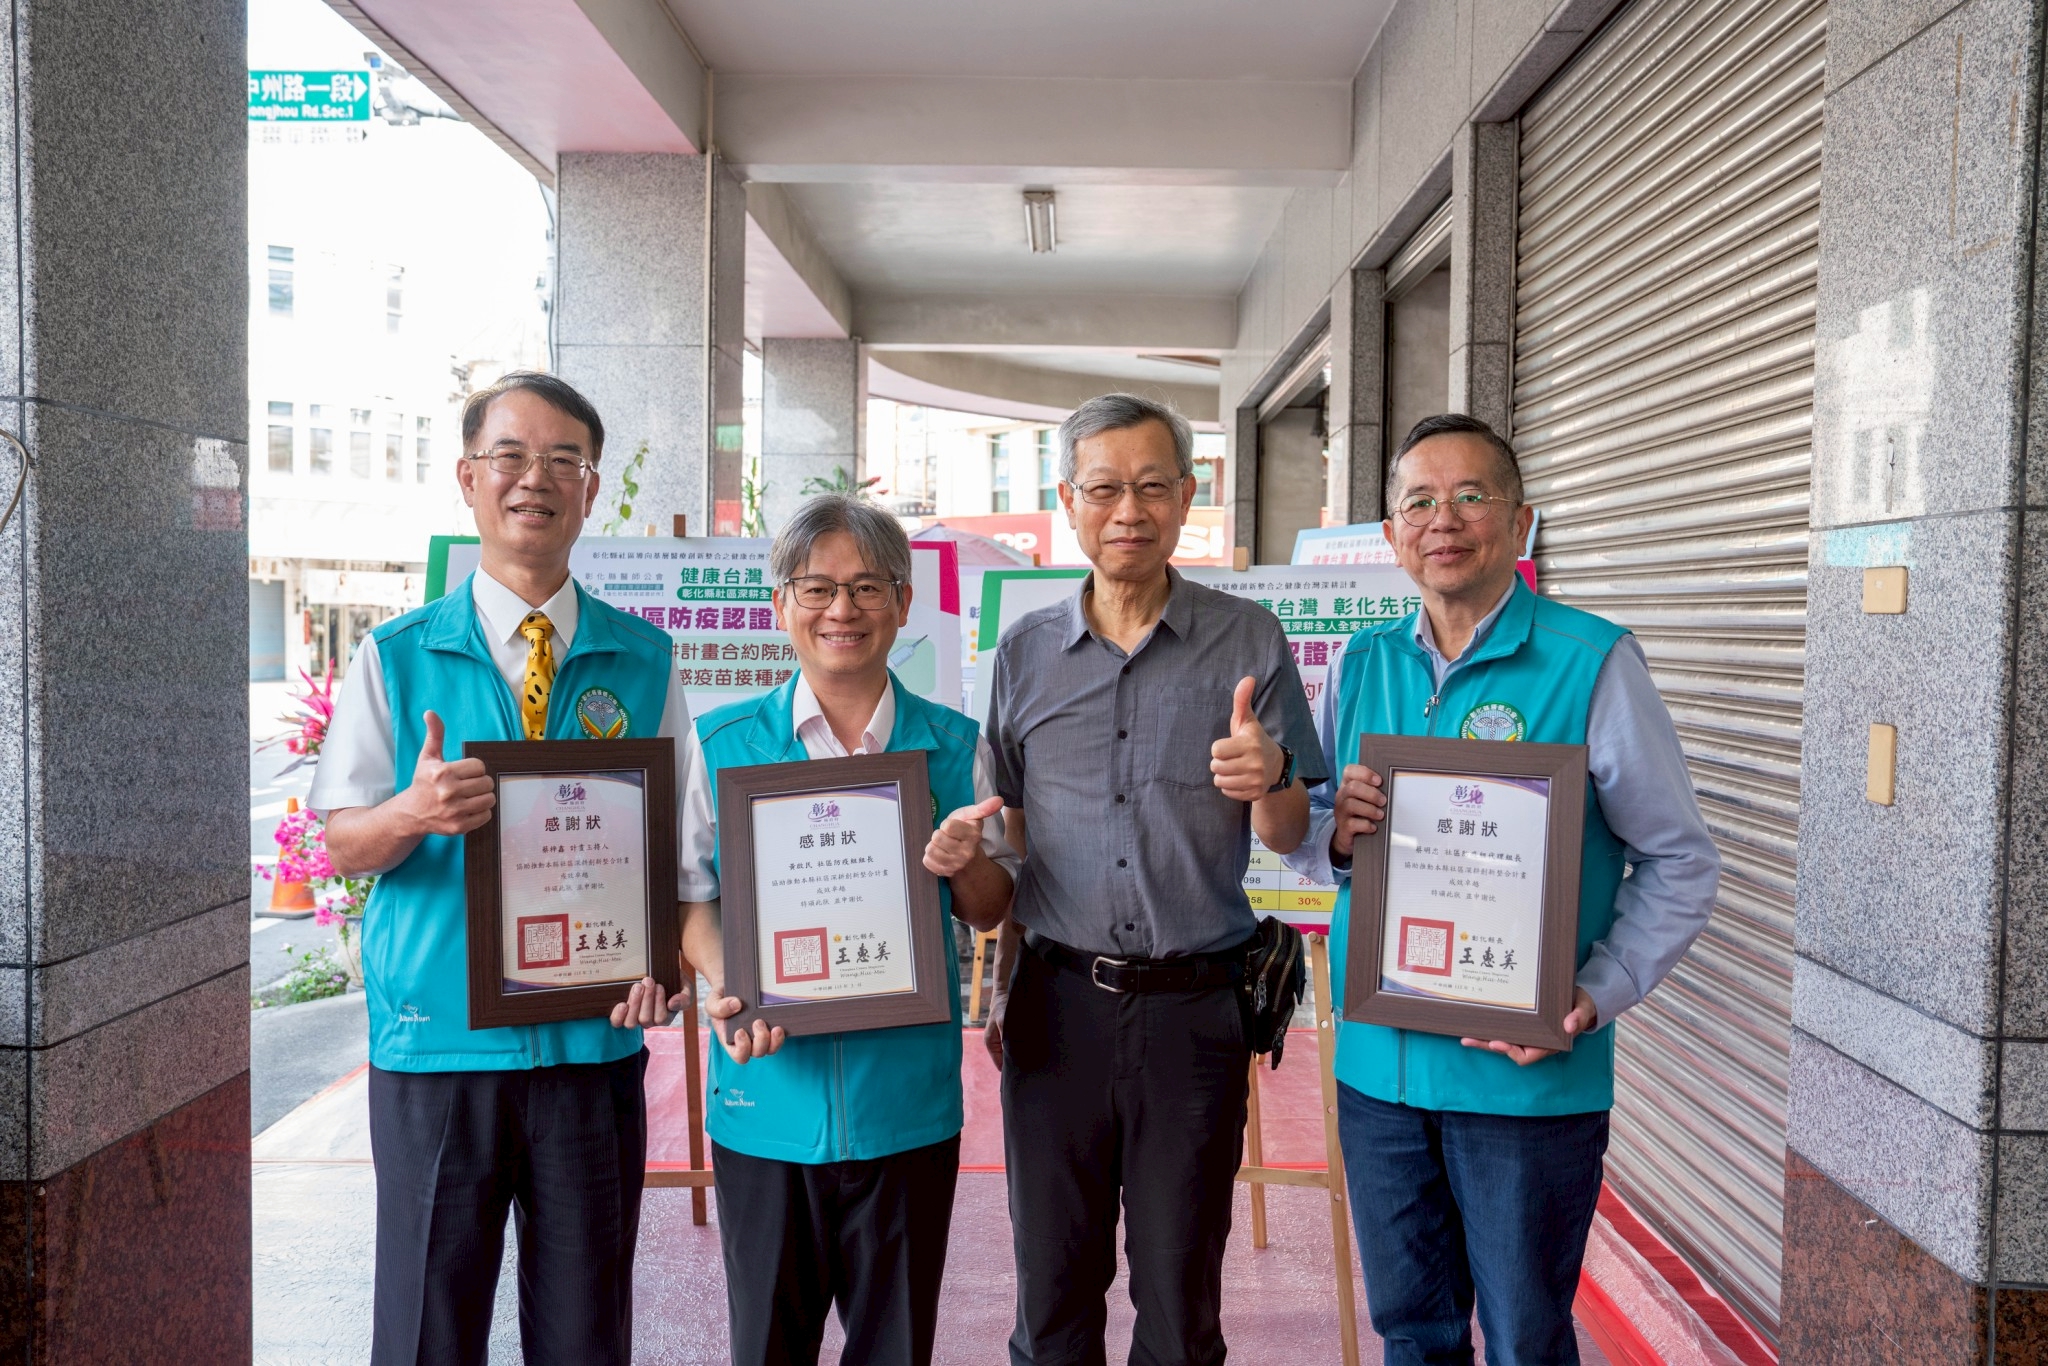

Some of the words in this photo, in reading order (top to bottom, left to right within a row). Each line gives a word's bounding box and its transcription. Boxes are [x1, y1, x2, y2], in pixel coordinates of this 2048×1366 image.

[680, 567, 763, 585] 健康台灣
[682, 588, 772, 600] 彰化縣社區深耕全
[1333, 596, 1422, 616] 彰化先行
[616, 607, 783, 631] 區防疫認證
[545, 814, 601, 832] 感謝狀
[1437, 818, 1498, 837] 感謝狀
[570, 843, 609, 852] 計畫主持人
[800, 830, 857, 849] 感謝狀
[818, 856, 874, 868] 社區防疫組組長
[1248, 896, 1262, 904] 58
[1297, 897, 1322, 906] 30%
[575, 929, 628, 952] 王惠美
[836, 941, 891, 965] 王惠美
[1459, 946, 1518, 971] 王惠美
